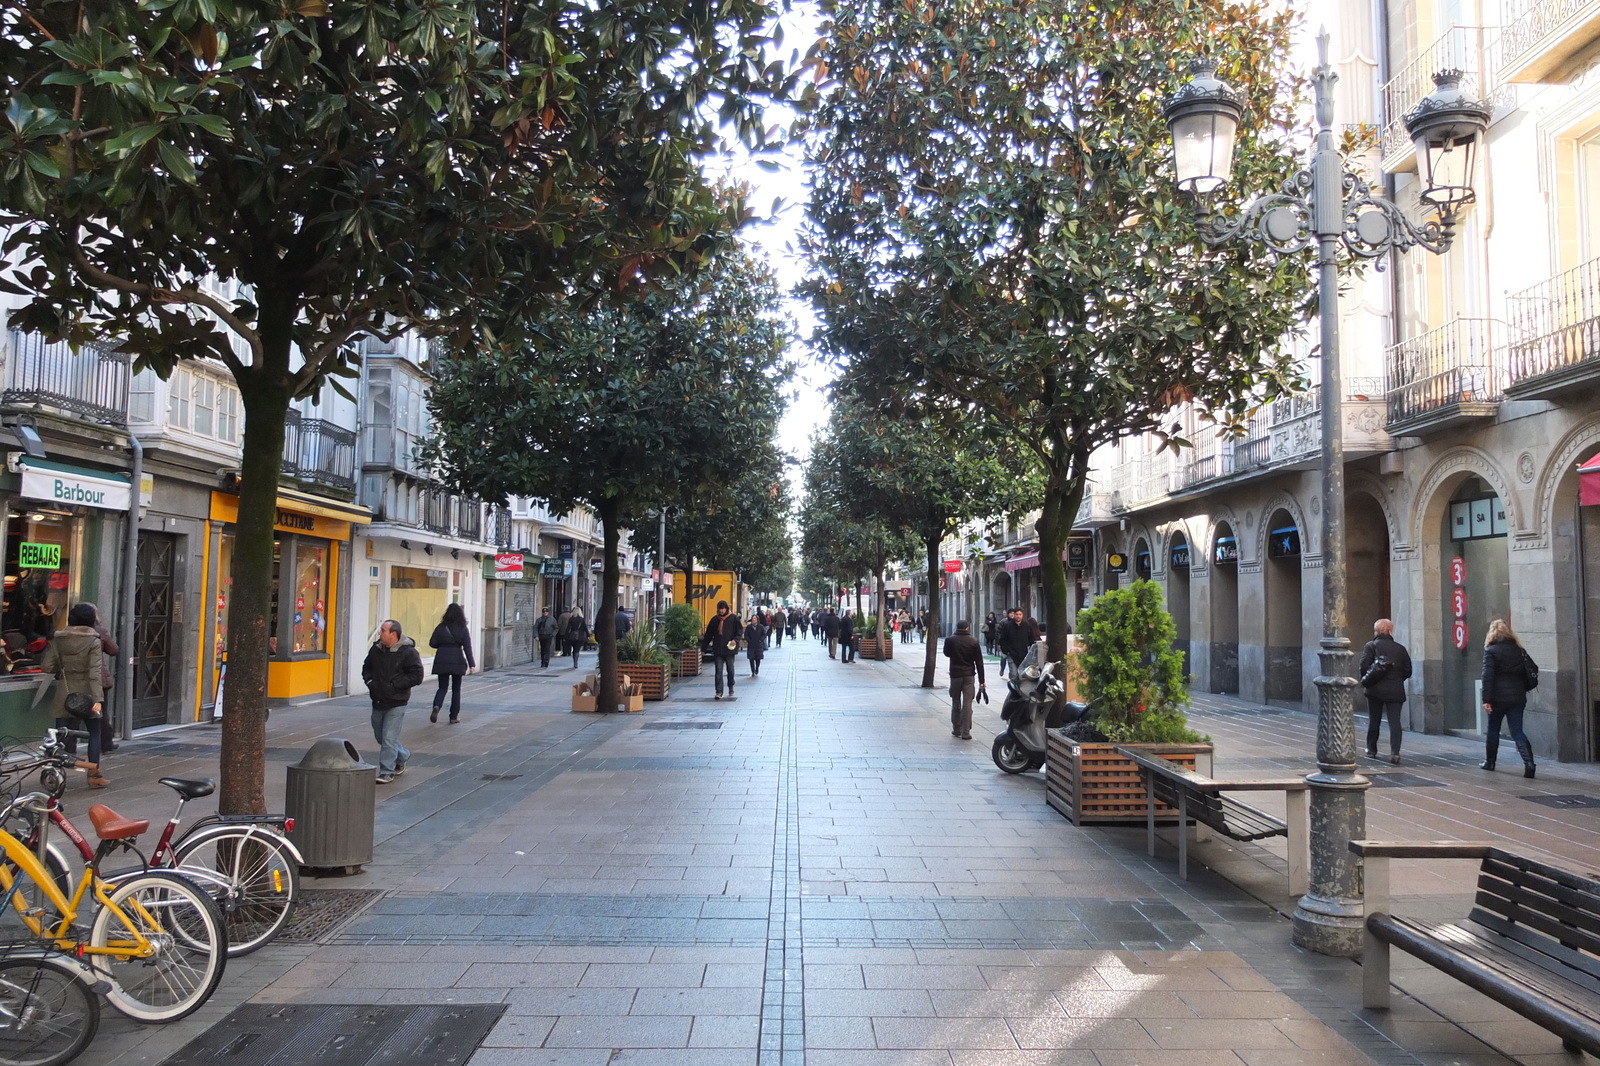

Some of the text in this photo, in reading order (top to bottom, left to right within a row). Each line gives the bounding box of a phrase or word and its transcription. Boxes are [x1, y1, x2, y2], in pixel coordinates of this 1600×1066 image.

[54, 479, 105, 504] Barbour
[1476, 513, 1486, 523] SA
[21, 545, 60, 566] REBAJAS
[499, 556, 521, 565] Coca-Cola
